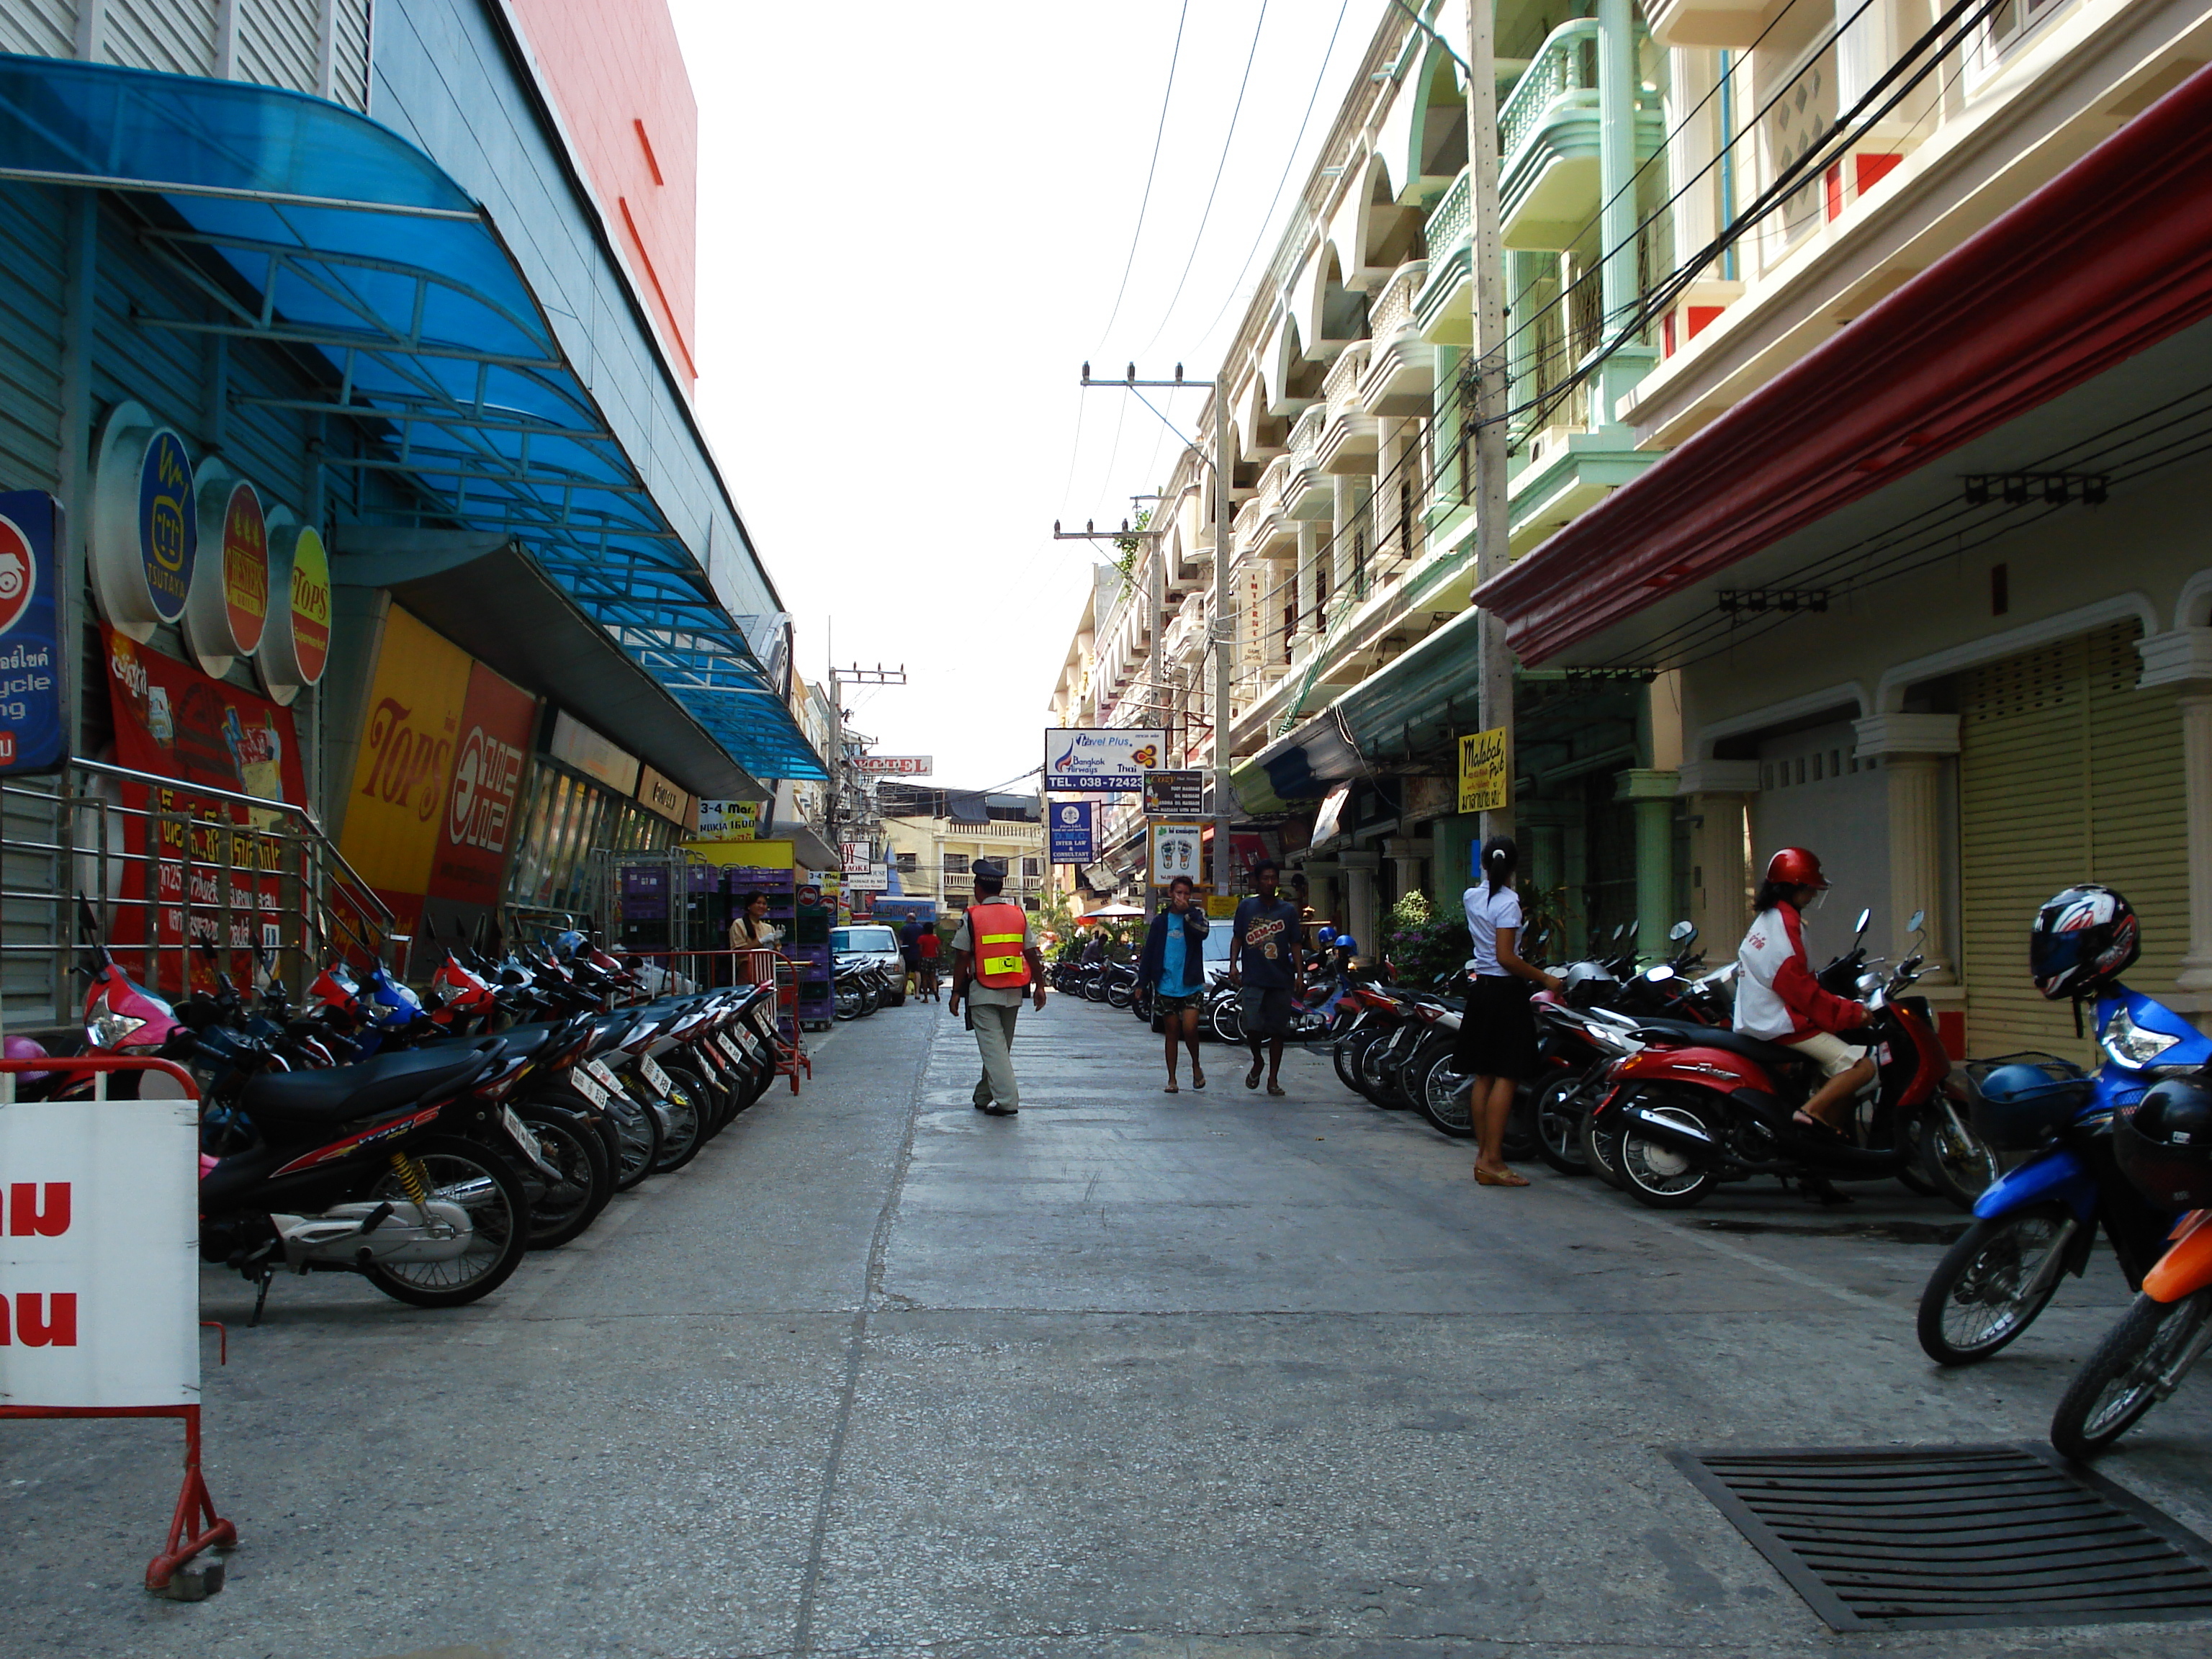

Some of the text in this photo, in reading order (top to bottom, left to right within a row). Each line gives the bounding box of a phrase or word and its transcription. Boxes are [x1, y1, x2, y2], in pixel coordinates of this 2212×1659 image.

[147, 562, 186, 601] TSUTAYA
[293, 567, 328, 620] TOPS
[1076, 733, 1105, 747] Travel
[361, 696, 451, 823] TOPS
[1072, 755, 1105, 768] Bangkok
[1489, 750, 1504, 780] Pub
[1066, 764, 1098, 775] Airways
[1117, 763, 1137, 773] Thai
[1048, 777, 1076, 787] TEL.
[1151, 775, 1175, 785] Cozy
[701, 803, 755, 814] 3-4 Mar.
[700, 820, 755, 832] NOKIA 1600
[1053, 832, 1088, 840] D.M.C.
[1264, 943, 1278, 959] 2
